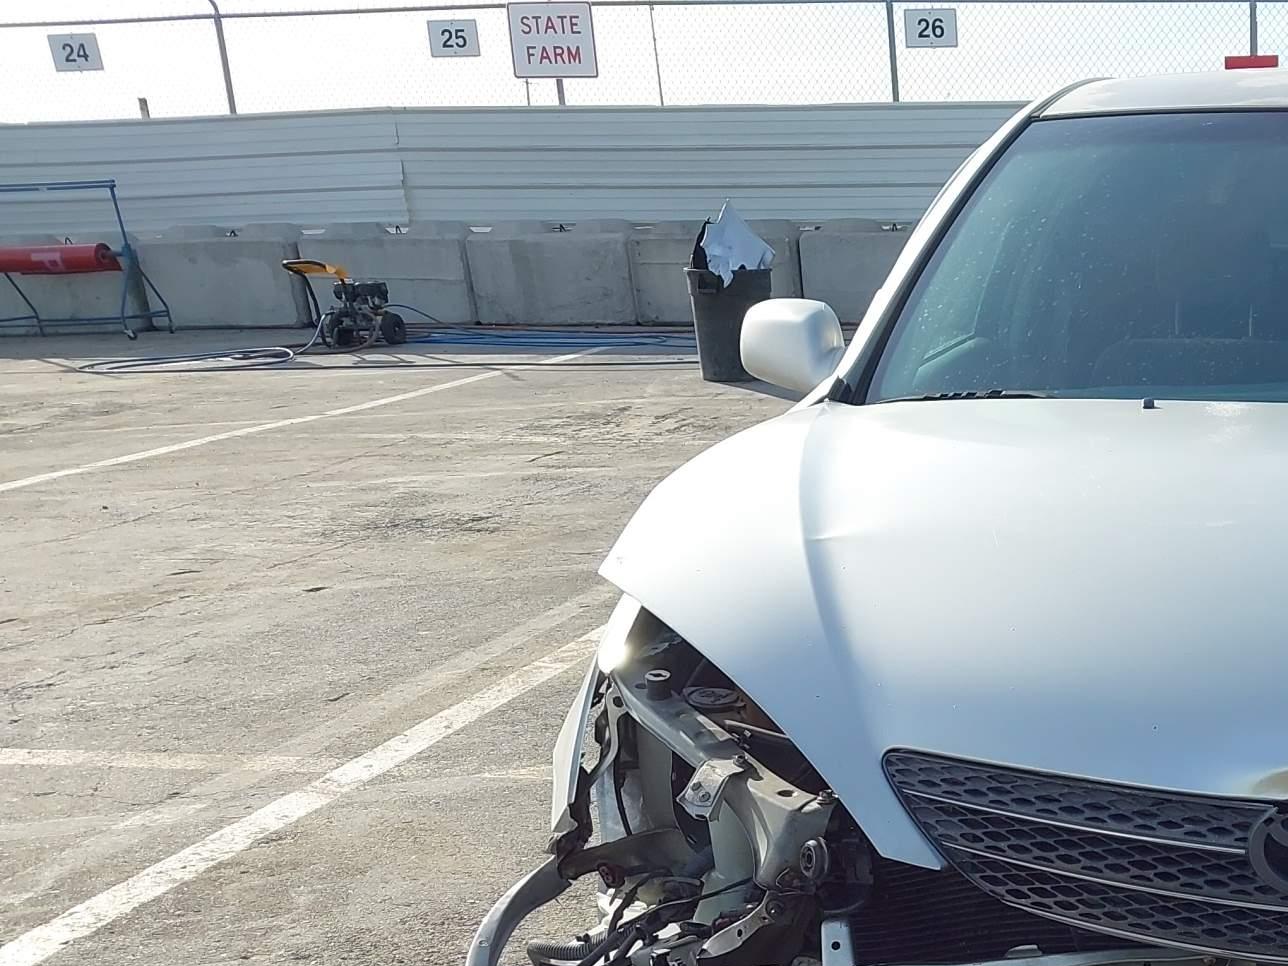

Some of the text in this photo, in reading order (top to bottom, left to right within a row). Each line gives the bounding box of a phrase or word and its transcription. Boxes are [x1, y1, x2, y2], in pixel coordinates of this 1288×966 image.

[520, 15, 582, 35] STATE
[916, 18, 945, 40] 26
[440, 29, 468, 49] 25
[62, 43, 89, 63] 24
[526, 45, 582, 66] FARM
